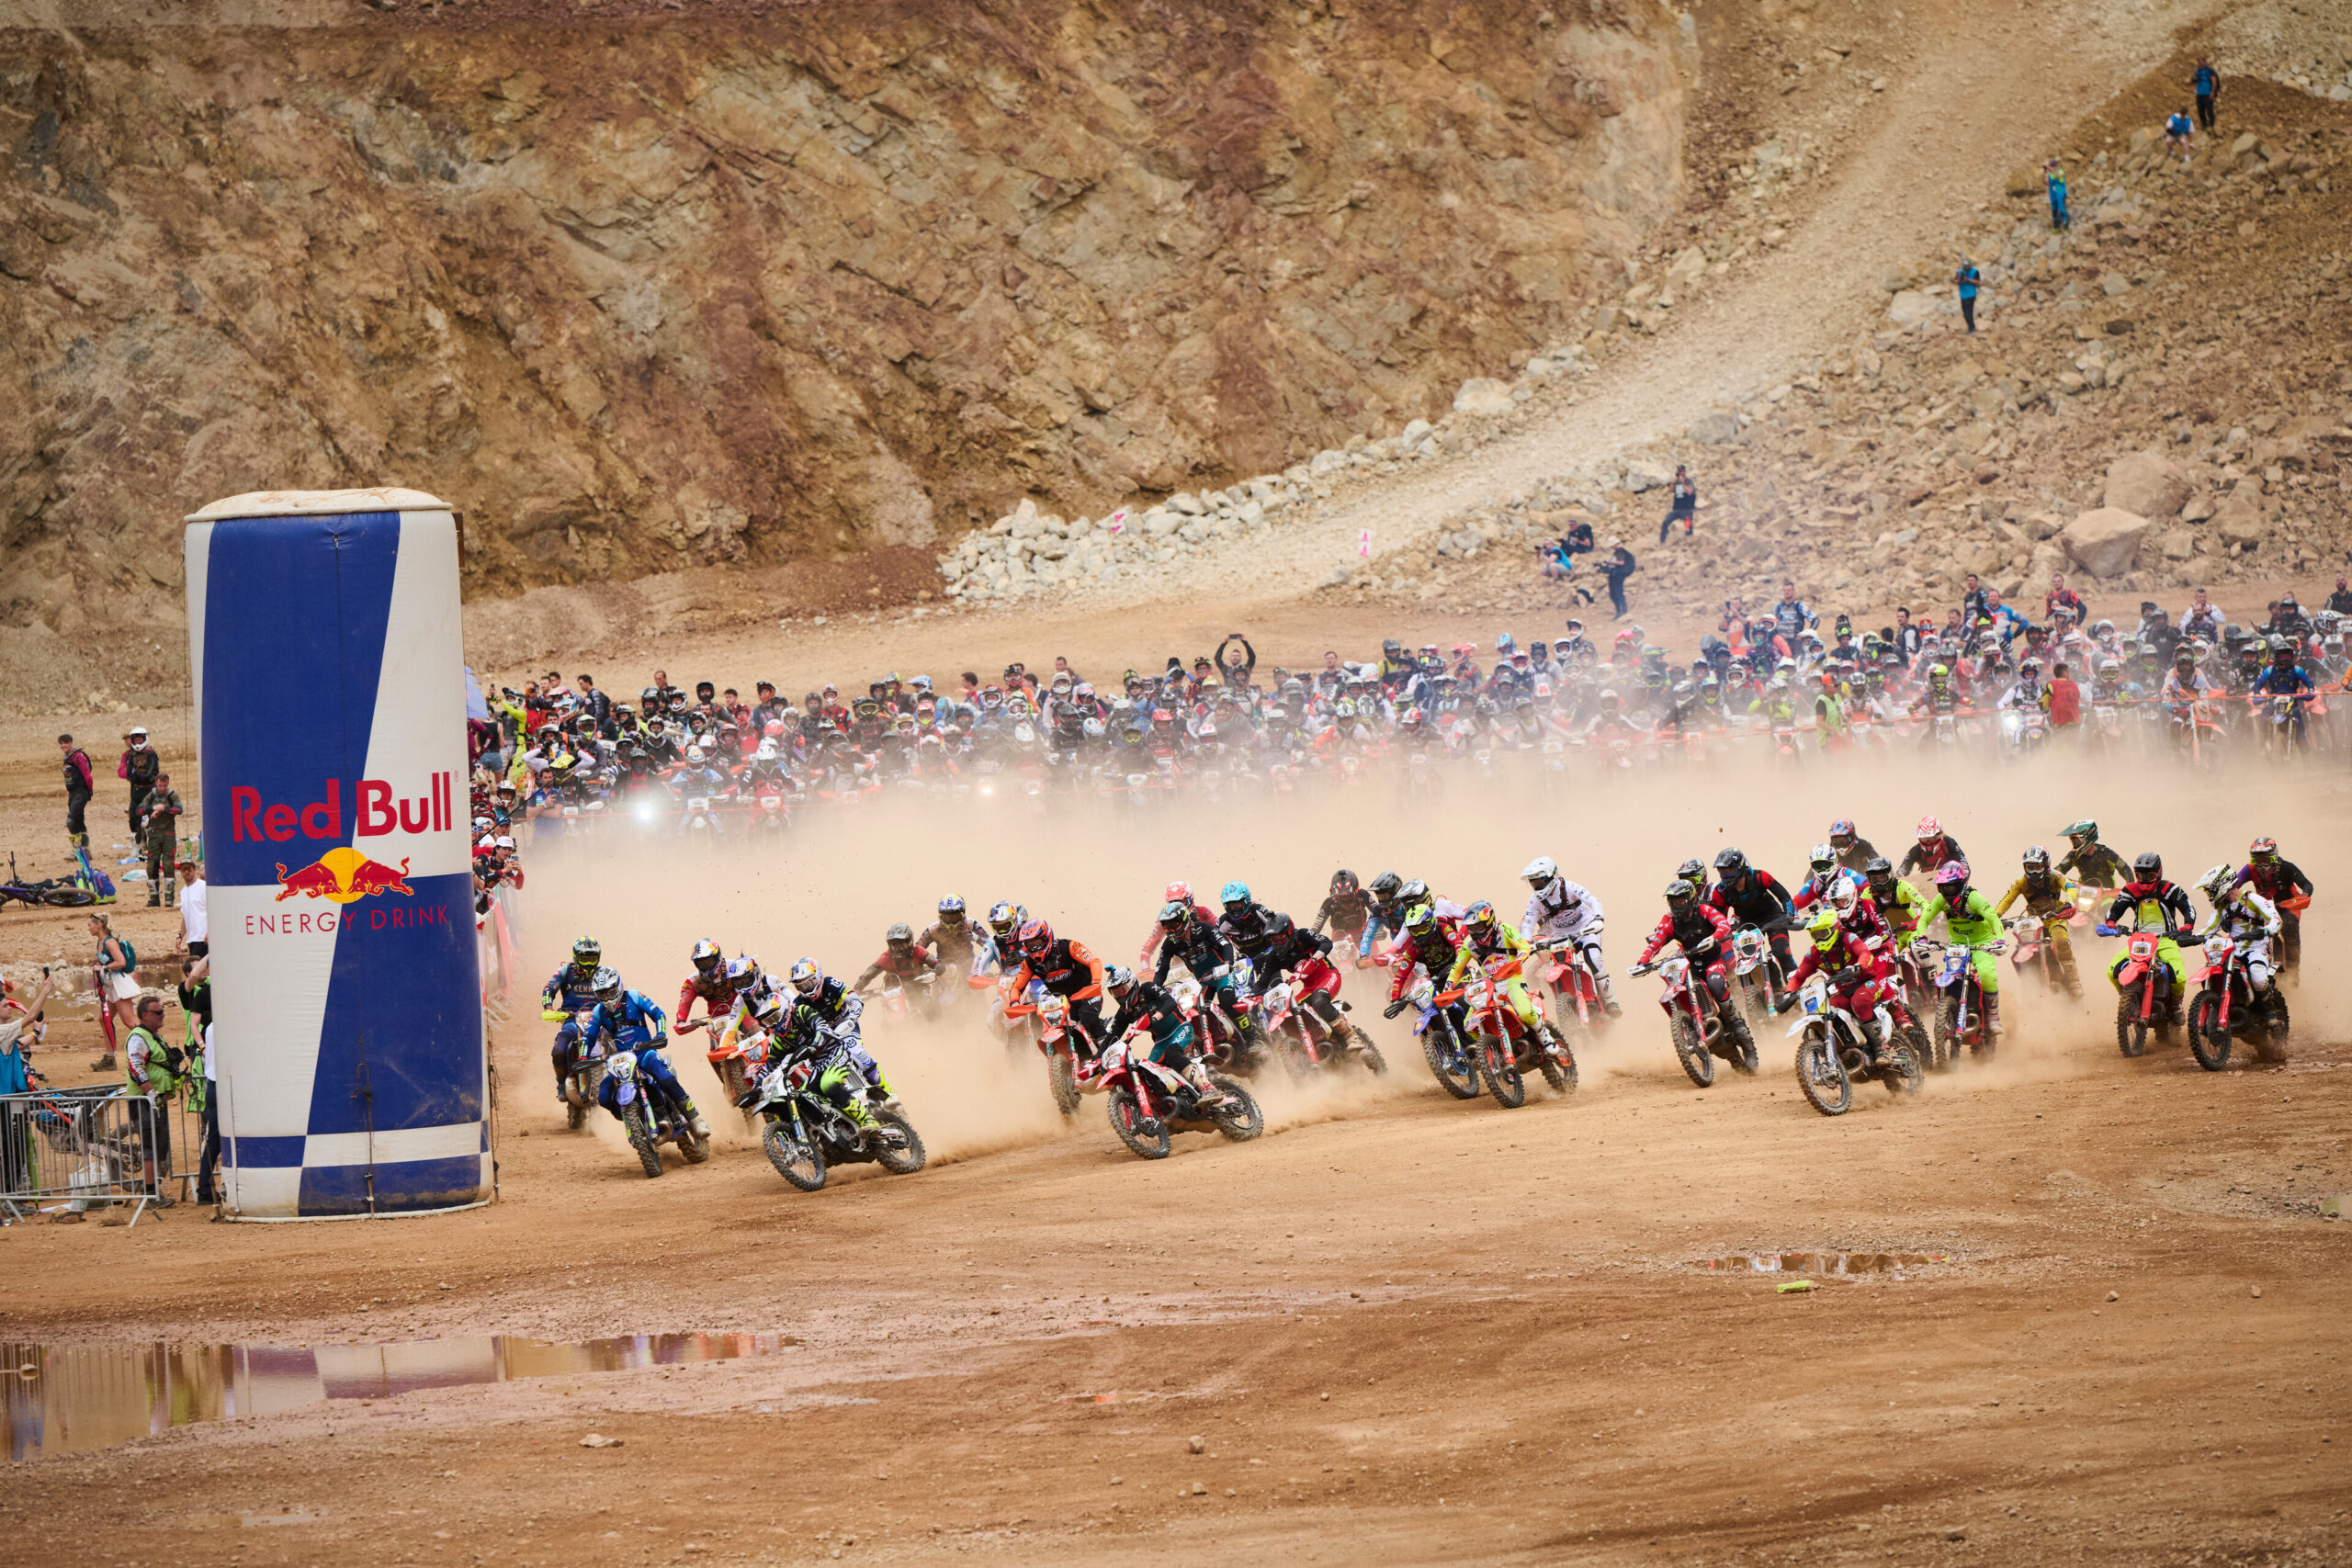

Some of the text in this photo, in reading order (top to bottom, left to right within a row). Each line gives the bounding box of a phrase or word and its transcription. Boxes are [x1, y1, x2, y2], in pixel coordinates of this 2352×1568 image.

[232, 772, 451, 842] Red Bull
[245, 905, 448, 935] ENERGY DRINK
[573, 984, 593, 993] KENN
